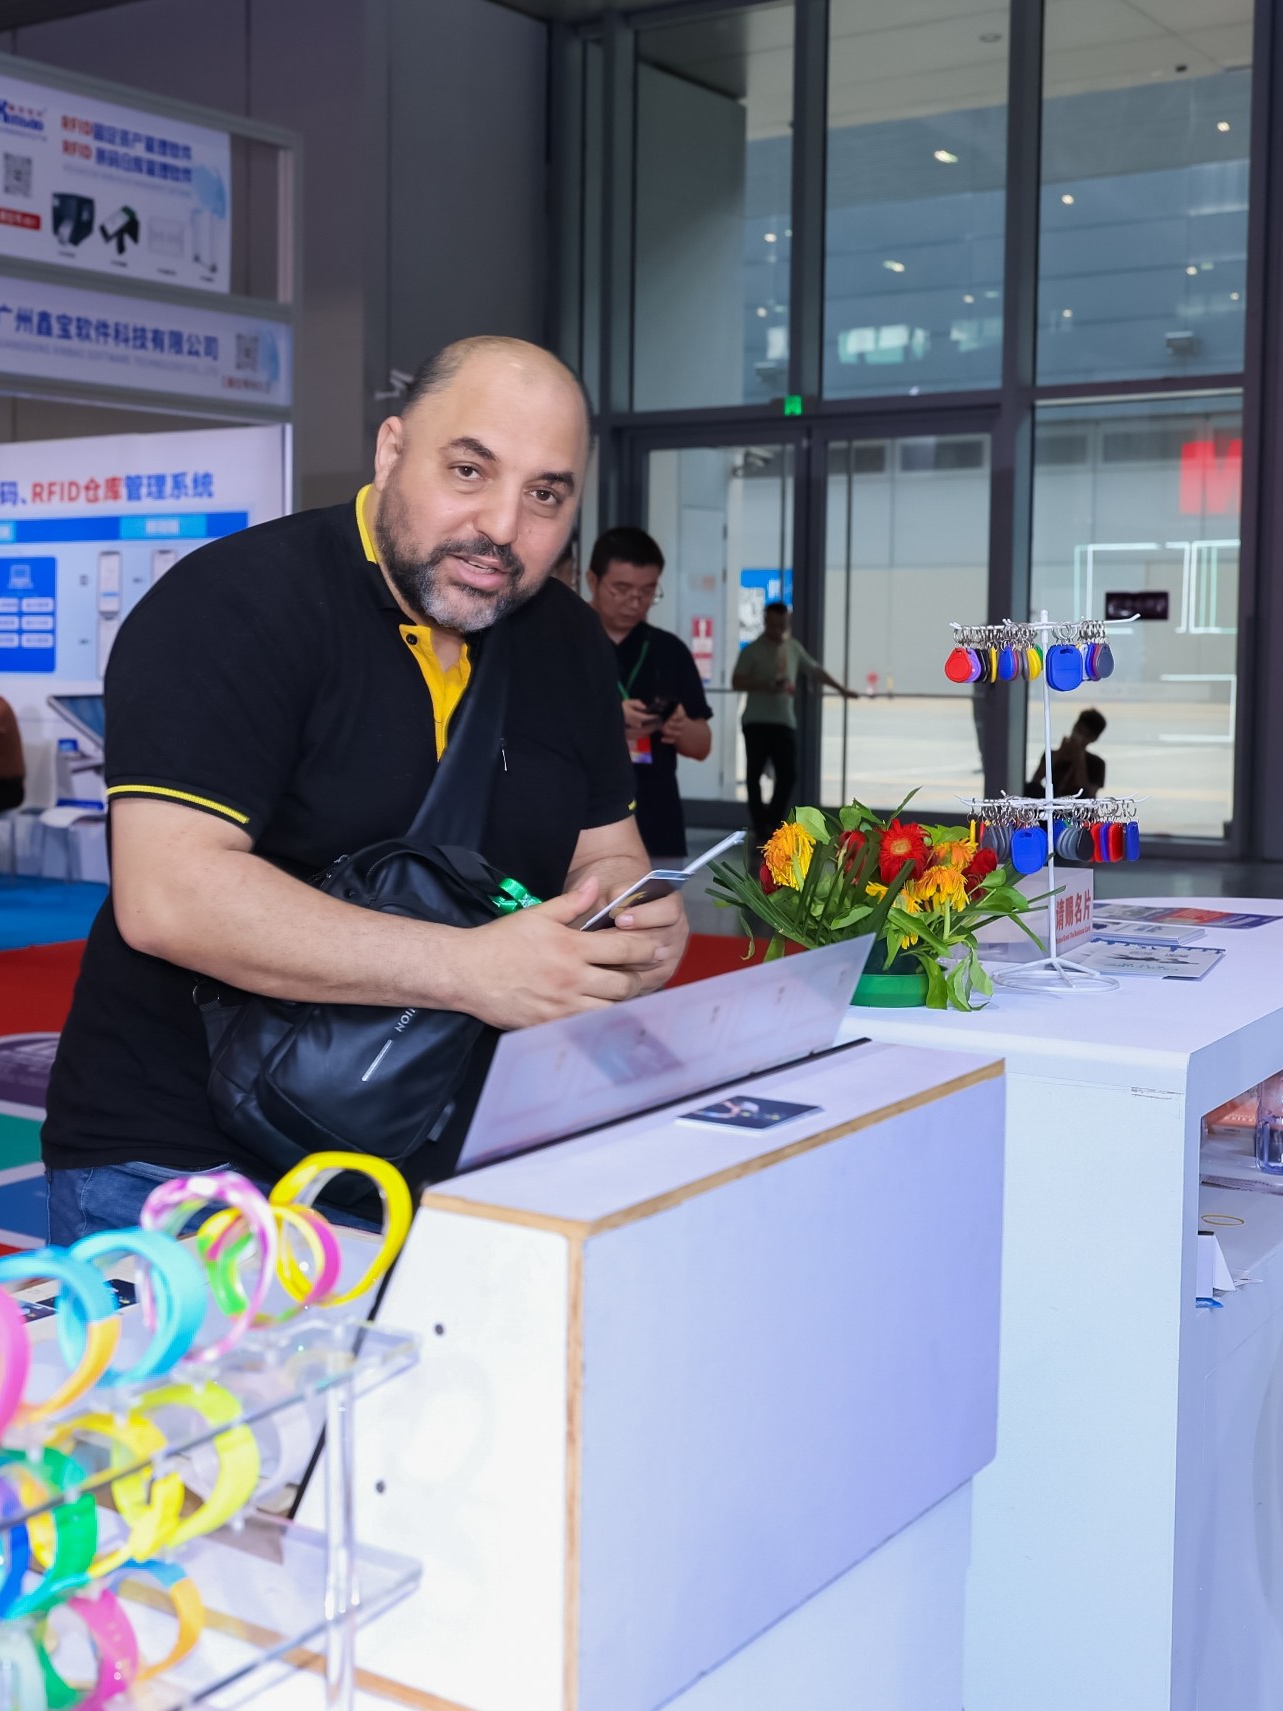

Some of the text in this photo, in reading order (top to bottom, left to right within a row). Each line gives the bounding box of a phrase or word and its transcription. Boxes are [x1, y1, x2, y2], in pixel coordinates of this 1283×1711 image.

[62, 140, 93, 160] RFID
[1056, 890, 1091, 931] 请赐名片
